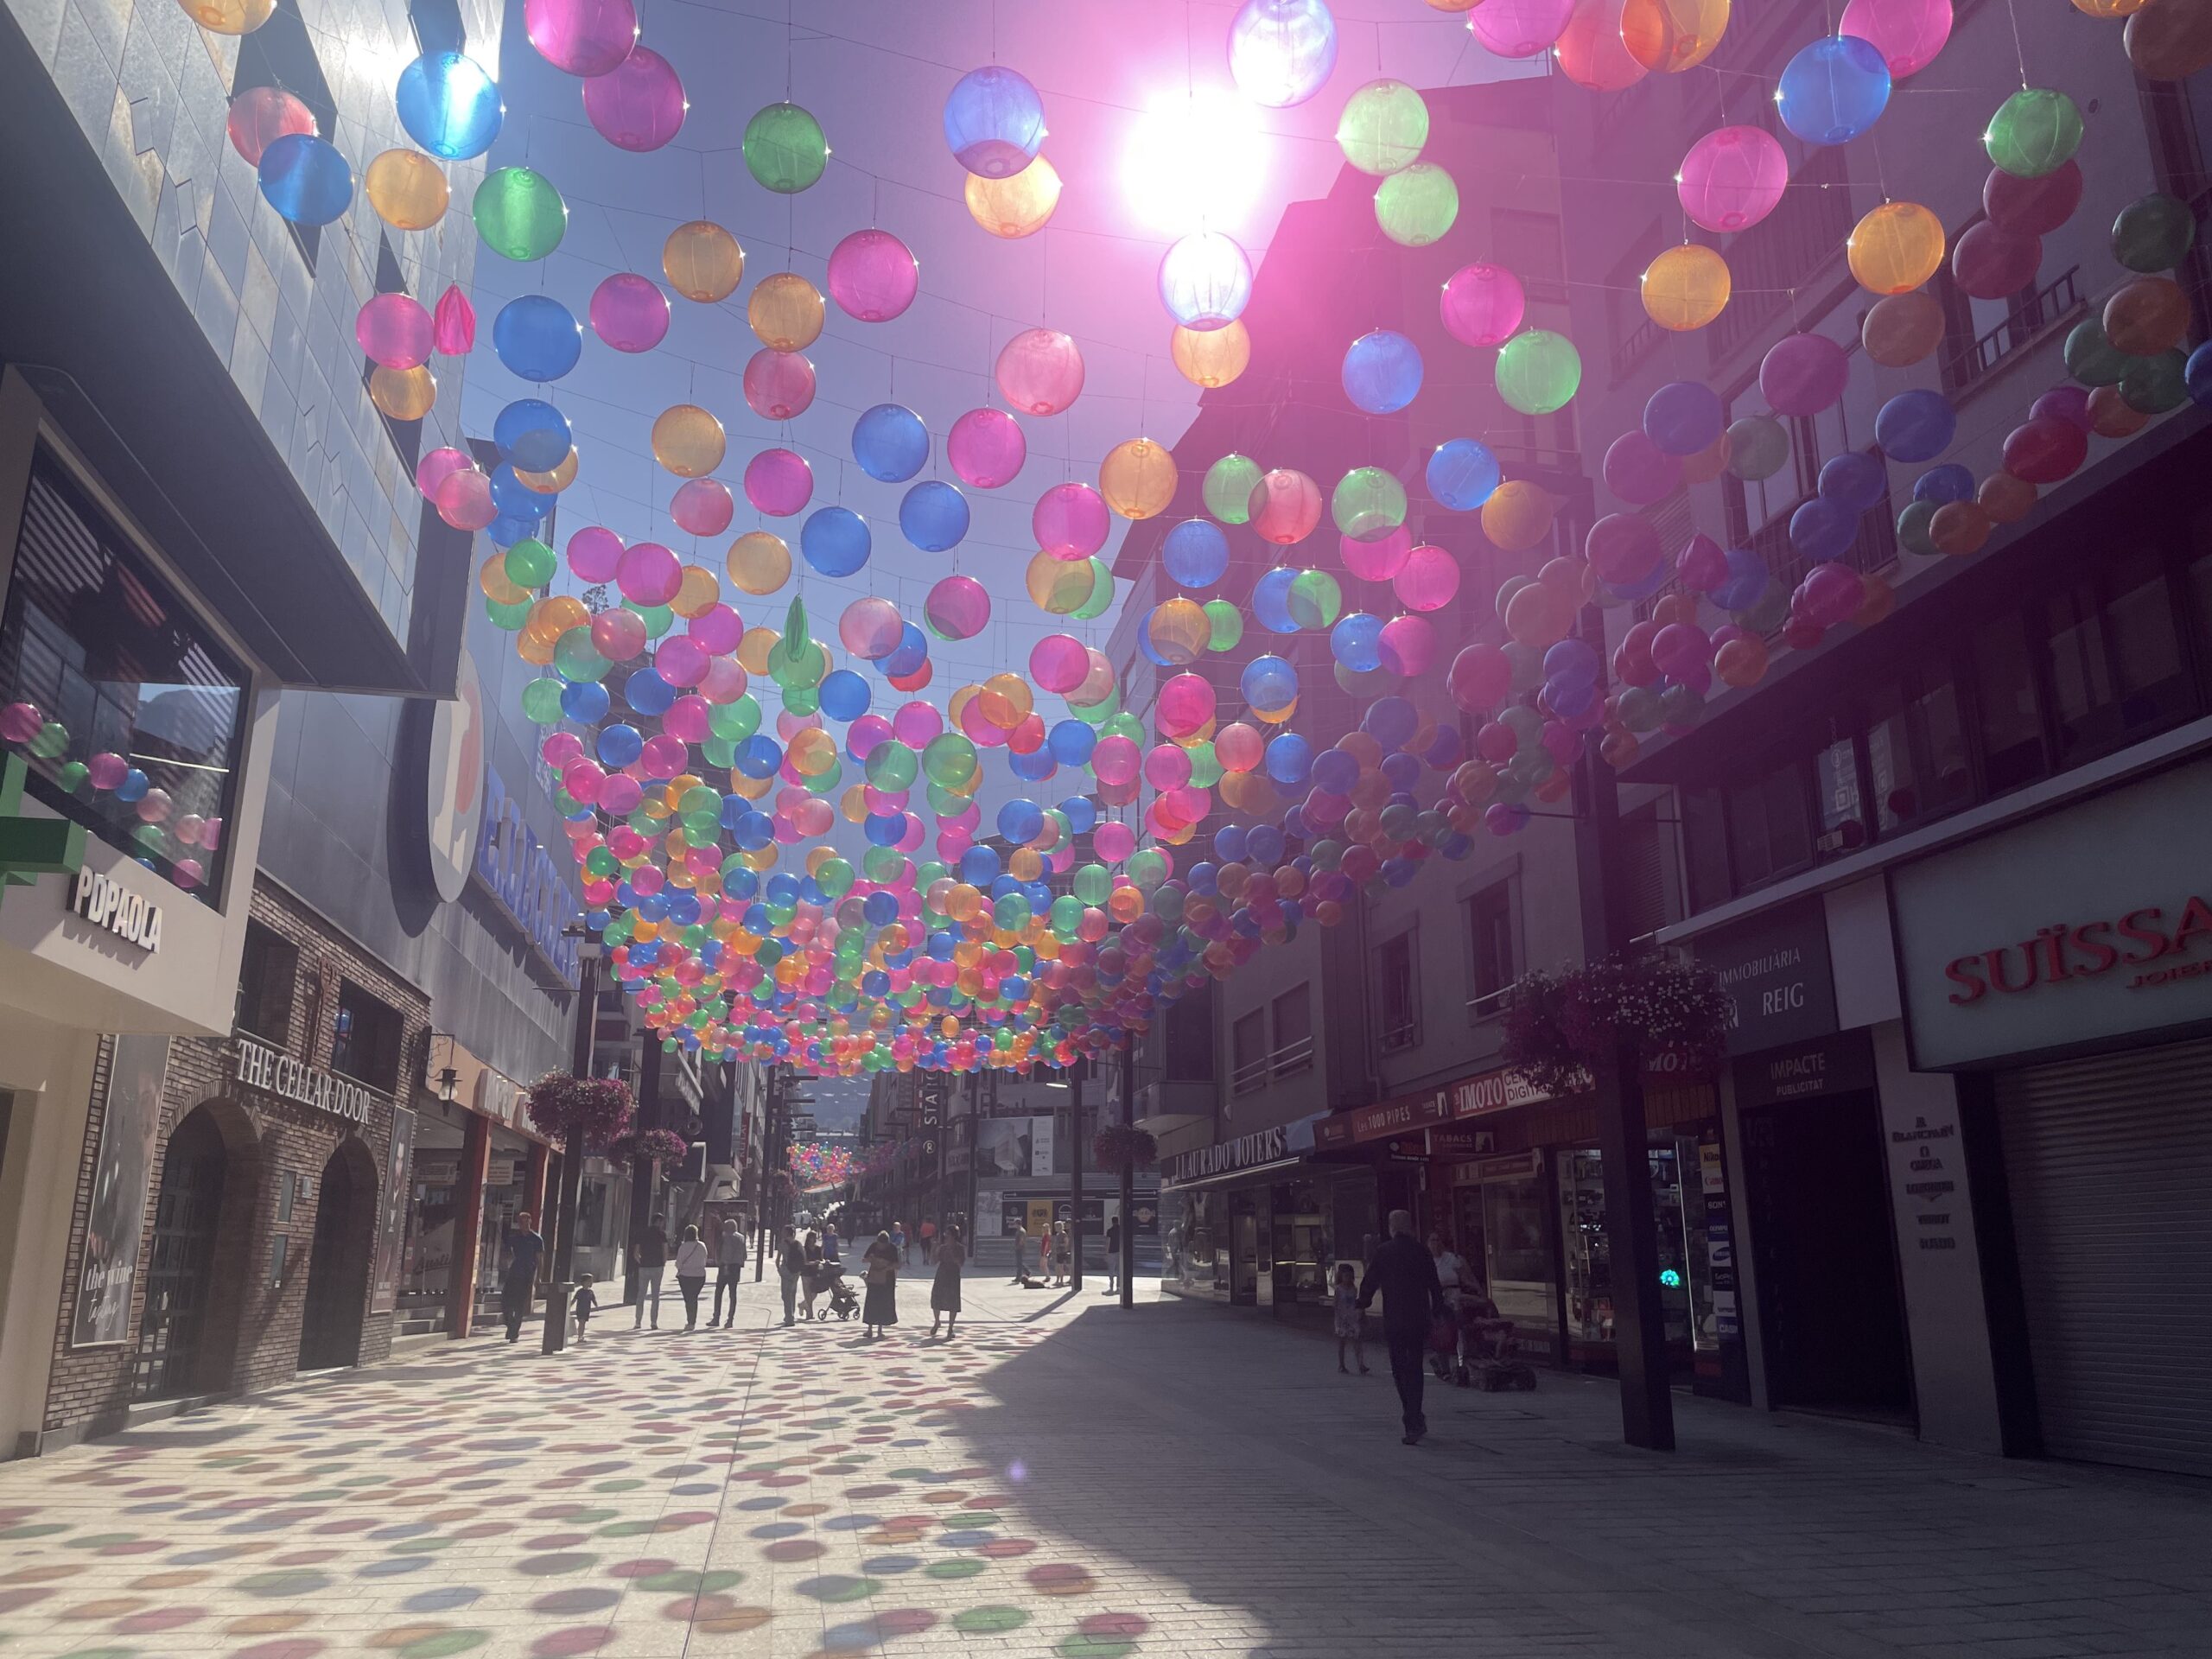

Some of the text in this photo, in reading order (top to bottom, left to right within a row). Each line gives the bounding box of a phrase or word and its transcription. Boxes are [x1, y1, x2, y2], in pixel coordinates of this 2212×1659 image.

[74, 866, 163, 954] PDPAOLA
[1763, 982, 1804, 1016] REIG
[236, 1039, 372, 1125] THE CELLAR DOOR
[1770, 1052, 1826, 1080] IMPACTE
[1459, 1077, 1503, 1112] IMOTO
[1508, 1083, 1547, 1102] DIGITA
[1777, 1077, 1824, 1096] PUBLICITAT
[1368, 1112, 1385, 1130] 1000
[1386, 1105, 1411, 1125] PIPES
[1175, 1141, 1230, 1181] LLAURADO
[1234, 1126, 1282, 1167] JOIERS
[86, 1259, 134, 1292] the wine
